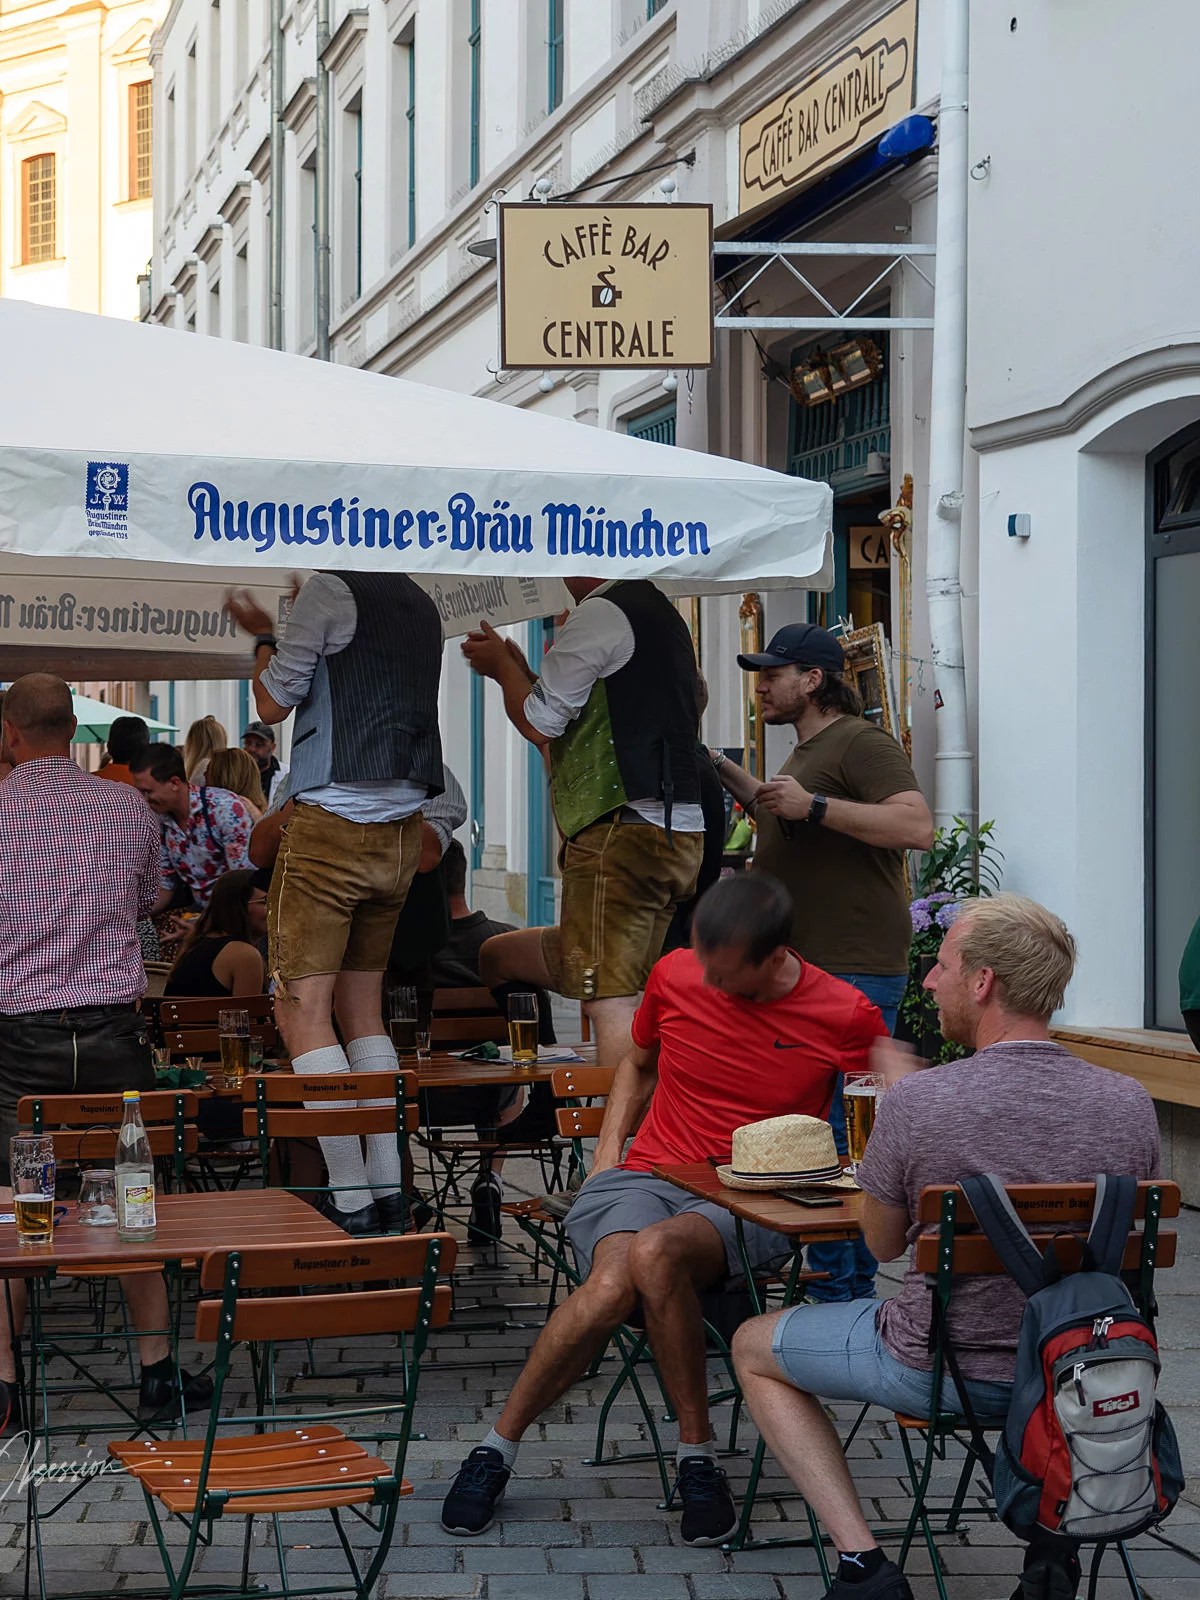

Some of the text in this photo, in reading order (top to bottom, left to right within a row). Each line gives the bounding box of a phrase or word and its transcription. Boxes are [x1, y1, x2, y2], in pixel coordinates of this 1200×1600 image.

[762, 49, 885, 177] CAFFÈ BAR CENTRALE
[543, 215, 671, 271] CAFFÈ BAR
[542, 320, 674, 358] CENTRALE
[541, 502, 711, 559] München
